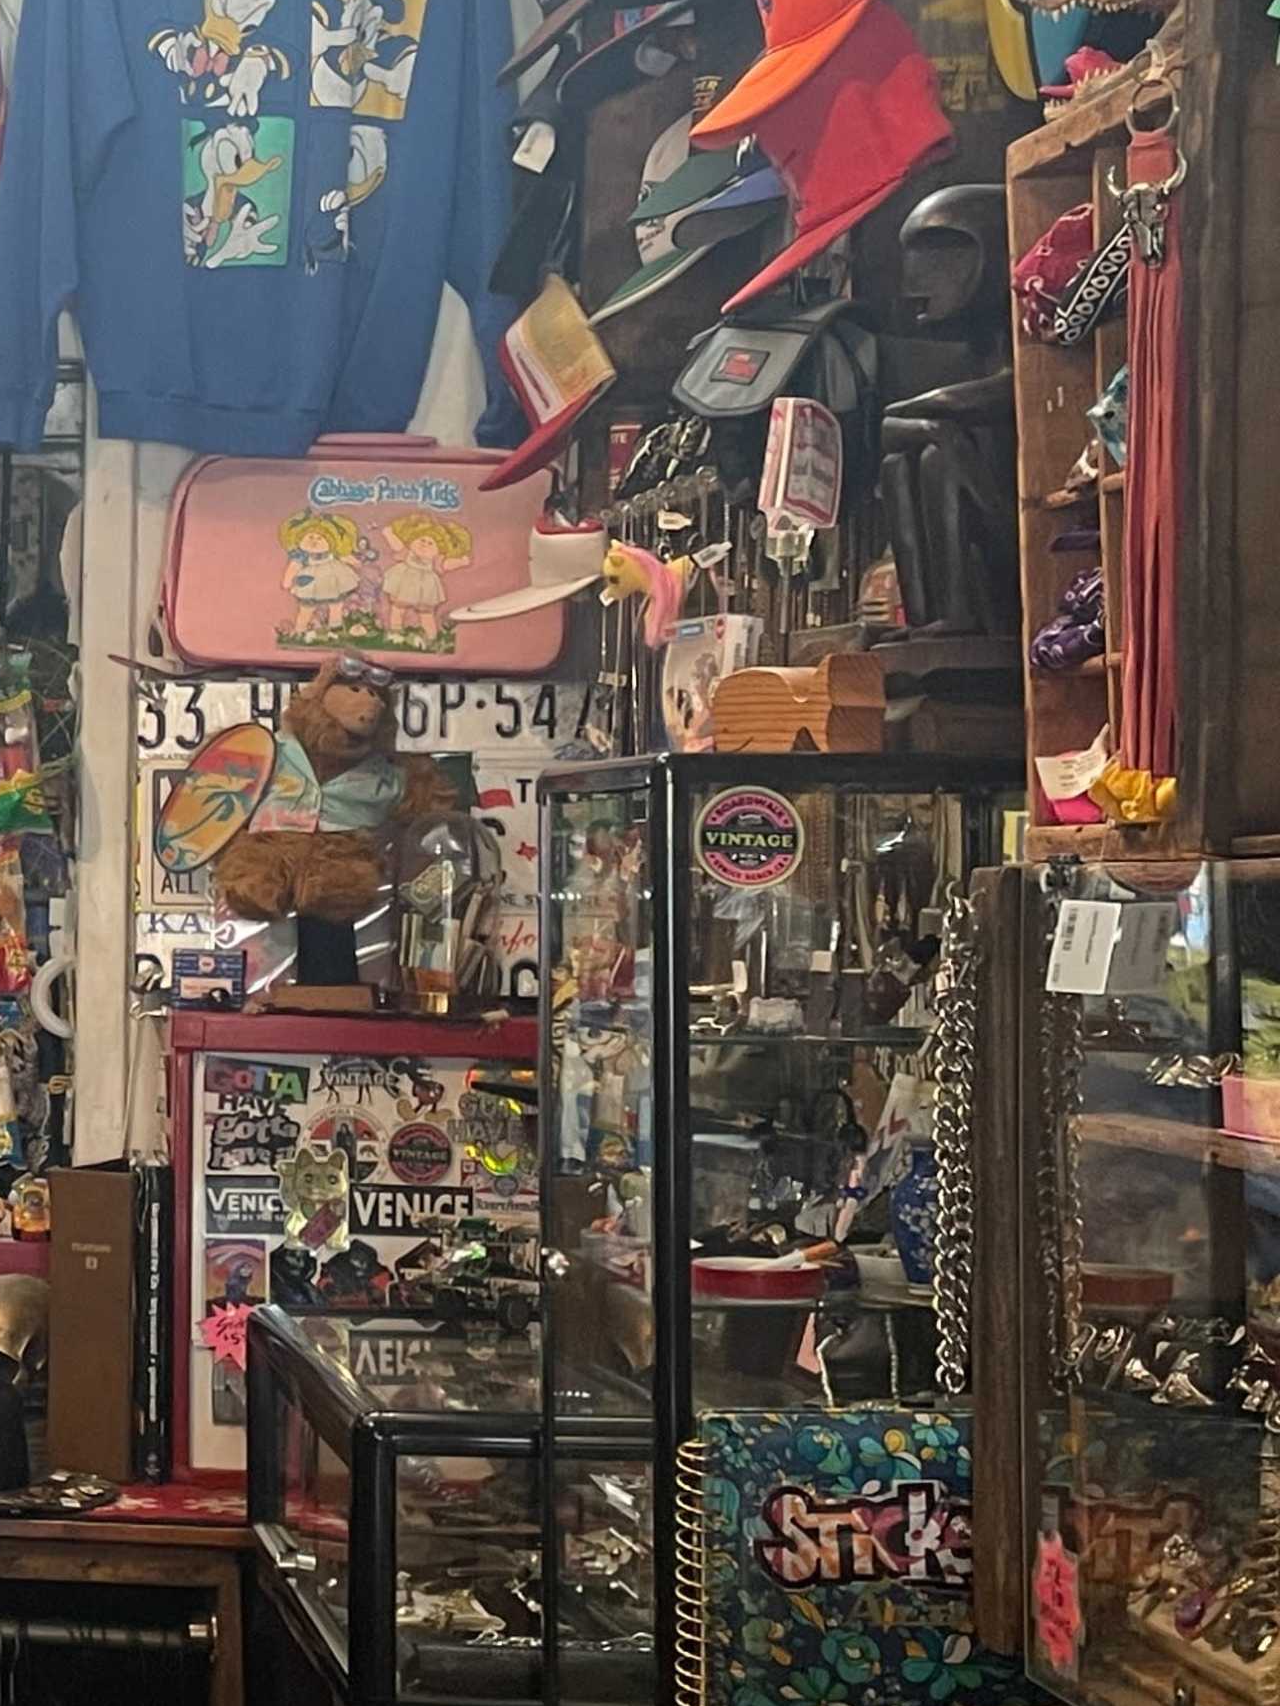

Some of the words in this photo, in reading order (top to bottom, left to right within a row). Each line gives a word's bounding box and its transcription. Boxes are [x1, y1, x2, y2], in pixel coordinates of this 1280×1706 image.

[418, 478, 462, 510] Kids
[706, 831, 794, 848] VINTAGE
[161, 875, 200, 894] ALL
[208, 1065, 306, 1103] GOTTA
[324, 1072, 396, 1087] VINTAGE
[215, 1115, 299, 1145] gotta
[354, 1190, 470, 1228] VENICE
